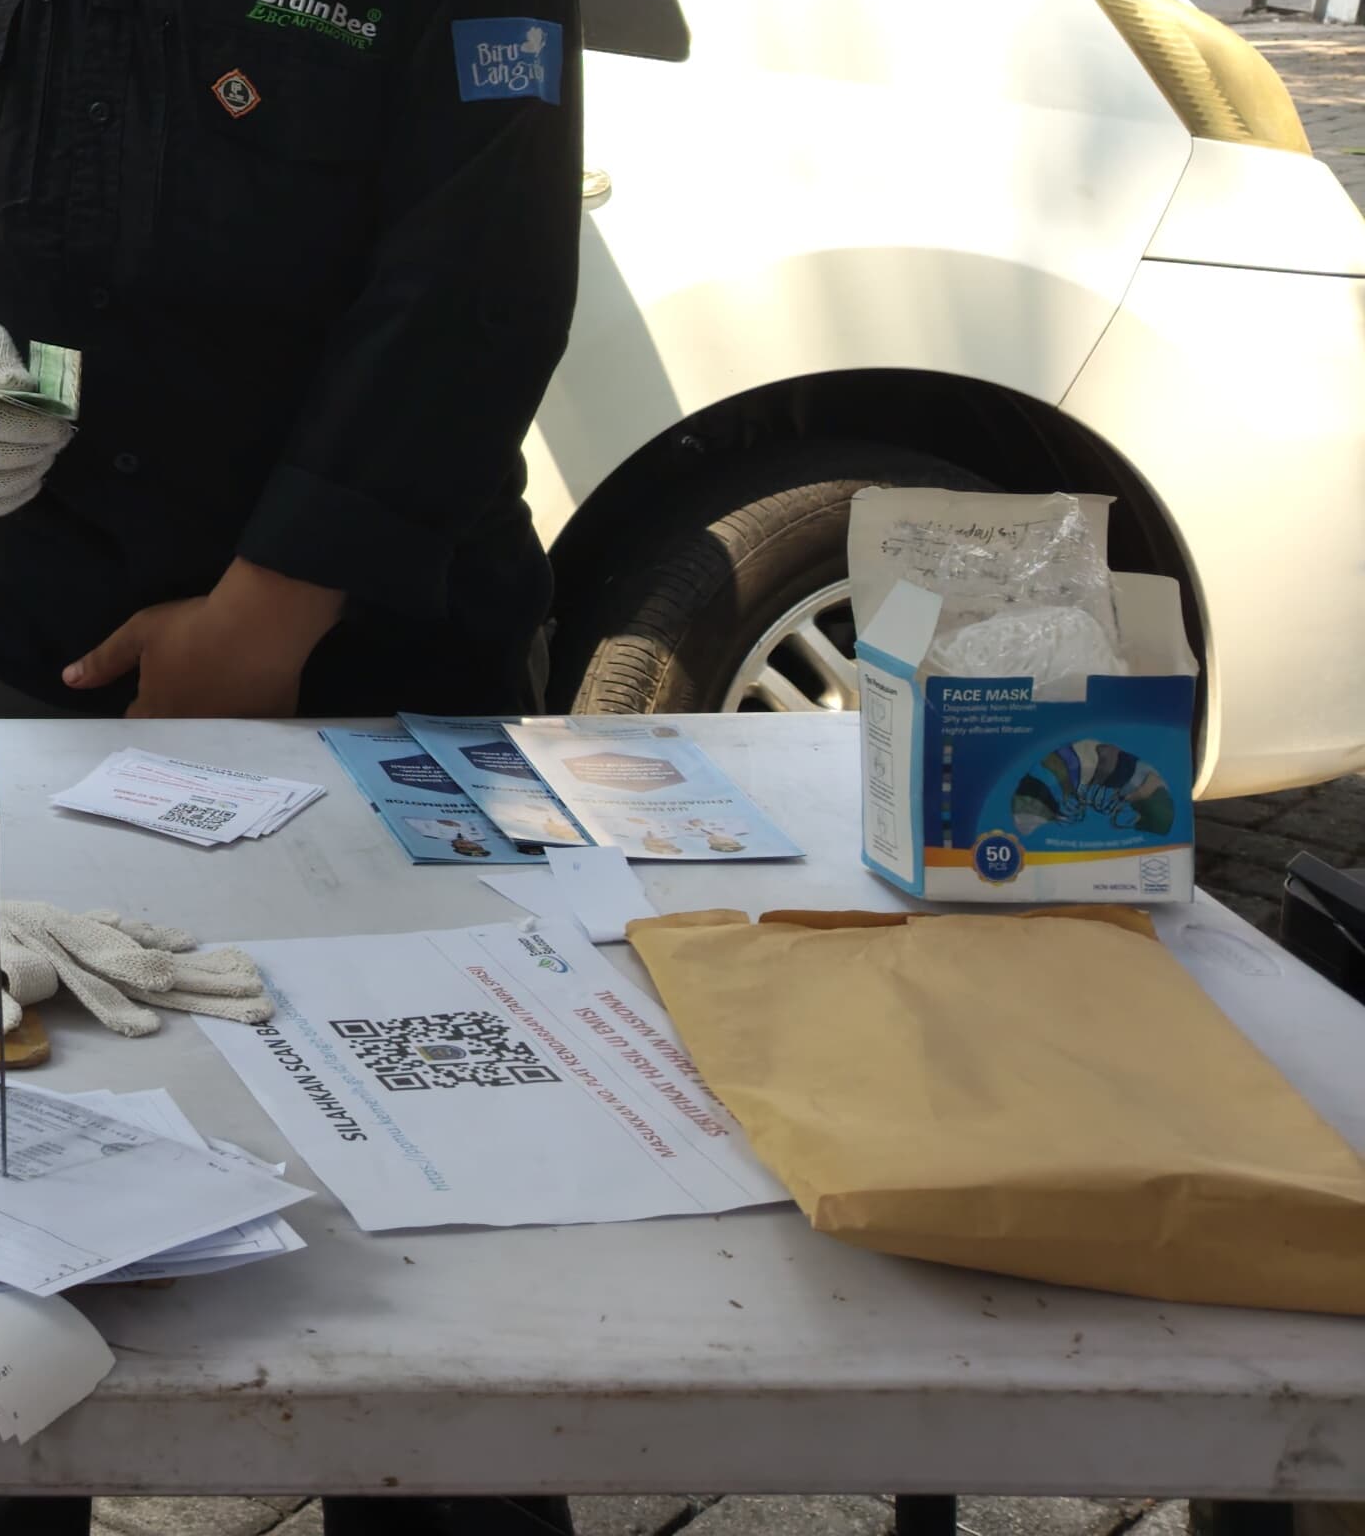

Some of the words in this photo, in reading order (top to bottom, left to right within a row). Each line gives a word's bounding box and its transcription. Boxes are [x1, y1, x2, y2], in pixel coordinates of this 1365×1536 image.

[943, 689, 981, 701] FACE
[985, 688, 1029, 701] MASK
[986, 846, 1011, 862] 50
[989, 862, 1007, 872] PCS
[573, 1007, 617, 1036] EMISI
[593, 990, 659, 1038] NASIONAL
[264, 1039, 311, 1073] SCAN
[521, 1016, 582, 1066] KENDARAAN
[653, 1038, 701, 1076] TAHUN
[573, 1067, 603, 1087] PLAT
[621, 1048, 665, 1080] HASIL
[293, 1074, 368, 1142] SILAHKAN
[652, 1080, 730, 1137] SERTIFIKAT
[613, 1105, 678, 1158] MASUKKAN
